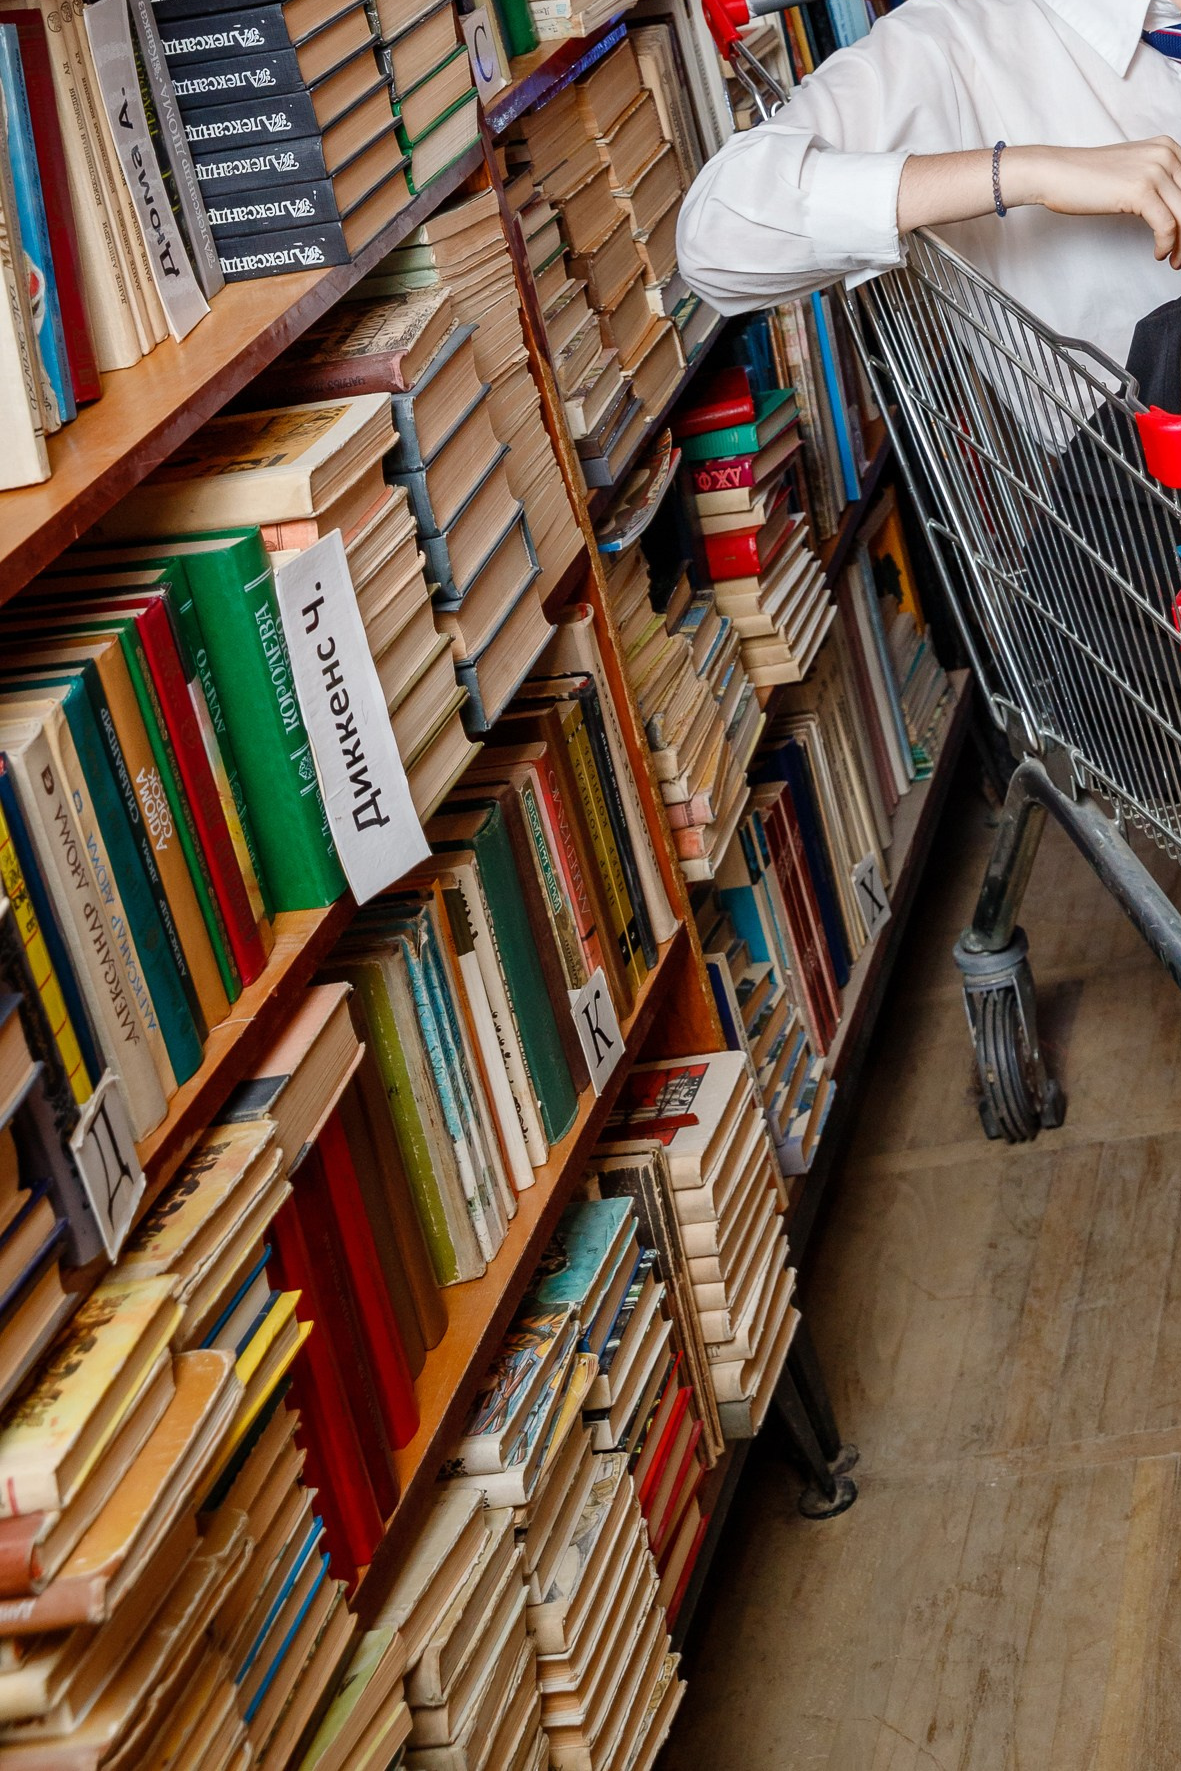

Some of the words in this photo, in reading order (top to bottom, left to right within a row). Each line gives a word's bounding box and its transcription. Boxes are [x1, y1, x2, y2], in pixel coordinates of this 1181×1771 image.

[160, 25, 265, 58] Александ
[474, 25, 494, 83] С
[111, 86, 134, 132] А.
[170, 66, 276, 98] Александ
[156, 82, 187, 157] ДЮМА
[125, 142, 180, 280] Дюма
[205, 194, 315, 229] Александр
[218, 244, 324, 276] Александ
[302, 580, 323, 635] Ч.
[252, 599, 303, 734] КОРОЛЕВА
[96, 706, 144, 823] СИЛЬВАНДИР
[316, 634, 391, 833] Диккенс
[142, 765, 176, 839] СОРОК
[49, 799, 90, 891] ДЮМА
[78, 899, 143, 1048] АЛЕКСАНДР
[582, 989, 614, 1067] К
